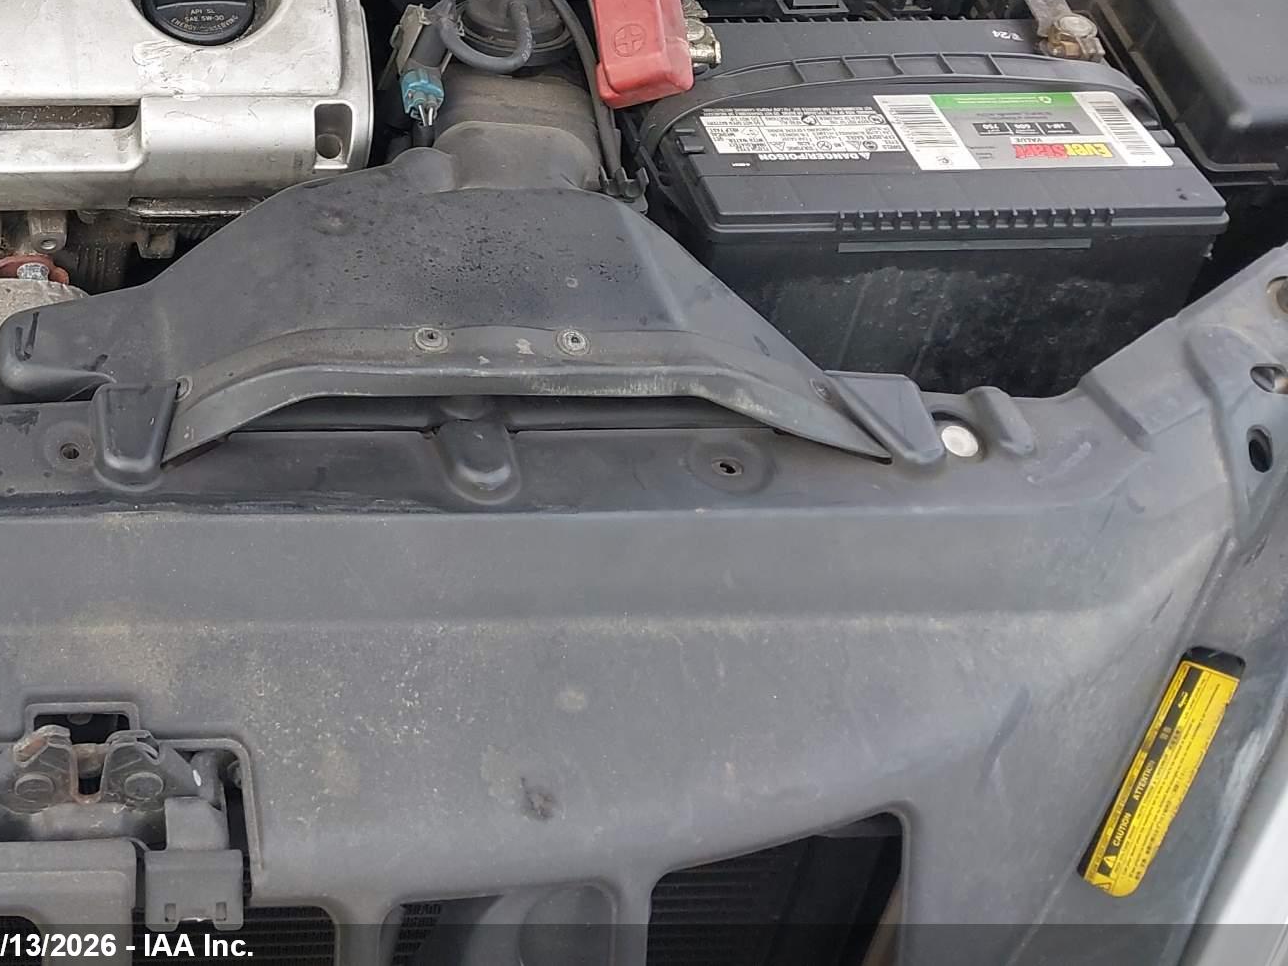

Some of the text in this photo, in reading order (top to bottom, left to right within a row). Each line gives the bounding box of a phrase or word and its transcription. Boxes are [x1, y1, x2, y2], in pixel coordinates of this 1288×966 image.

[758, 152, 860, 162] DANGER/POISON
[1015, 143, 1113, 159] EverStart
[1112, 812, 1132, 847] CAUTION
[1132, 759, 1156, 801] ATTENTION
